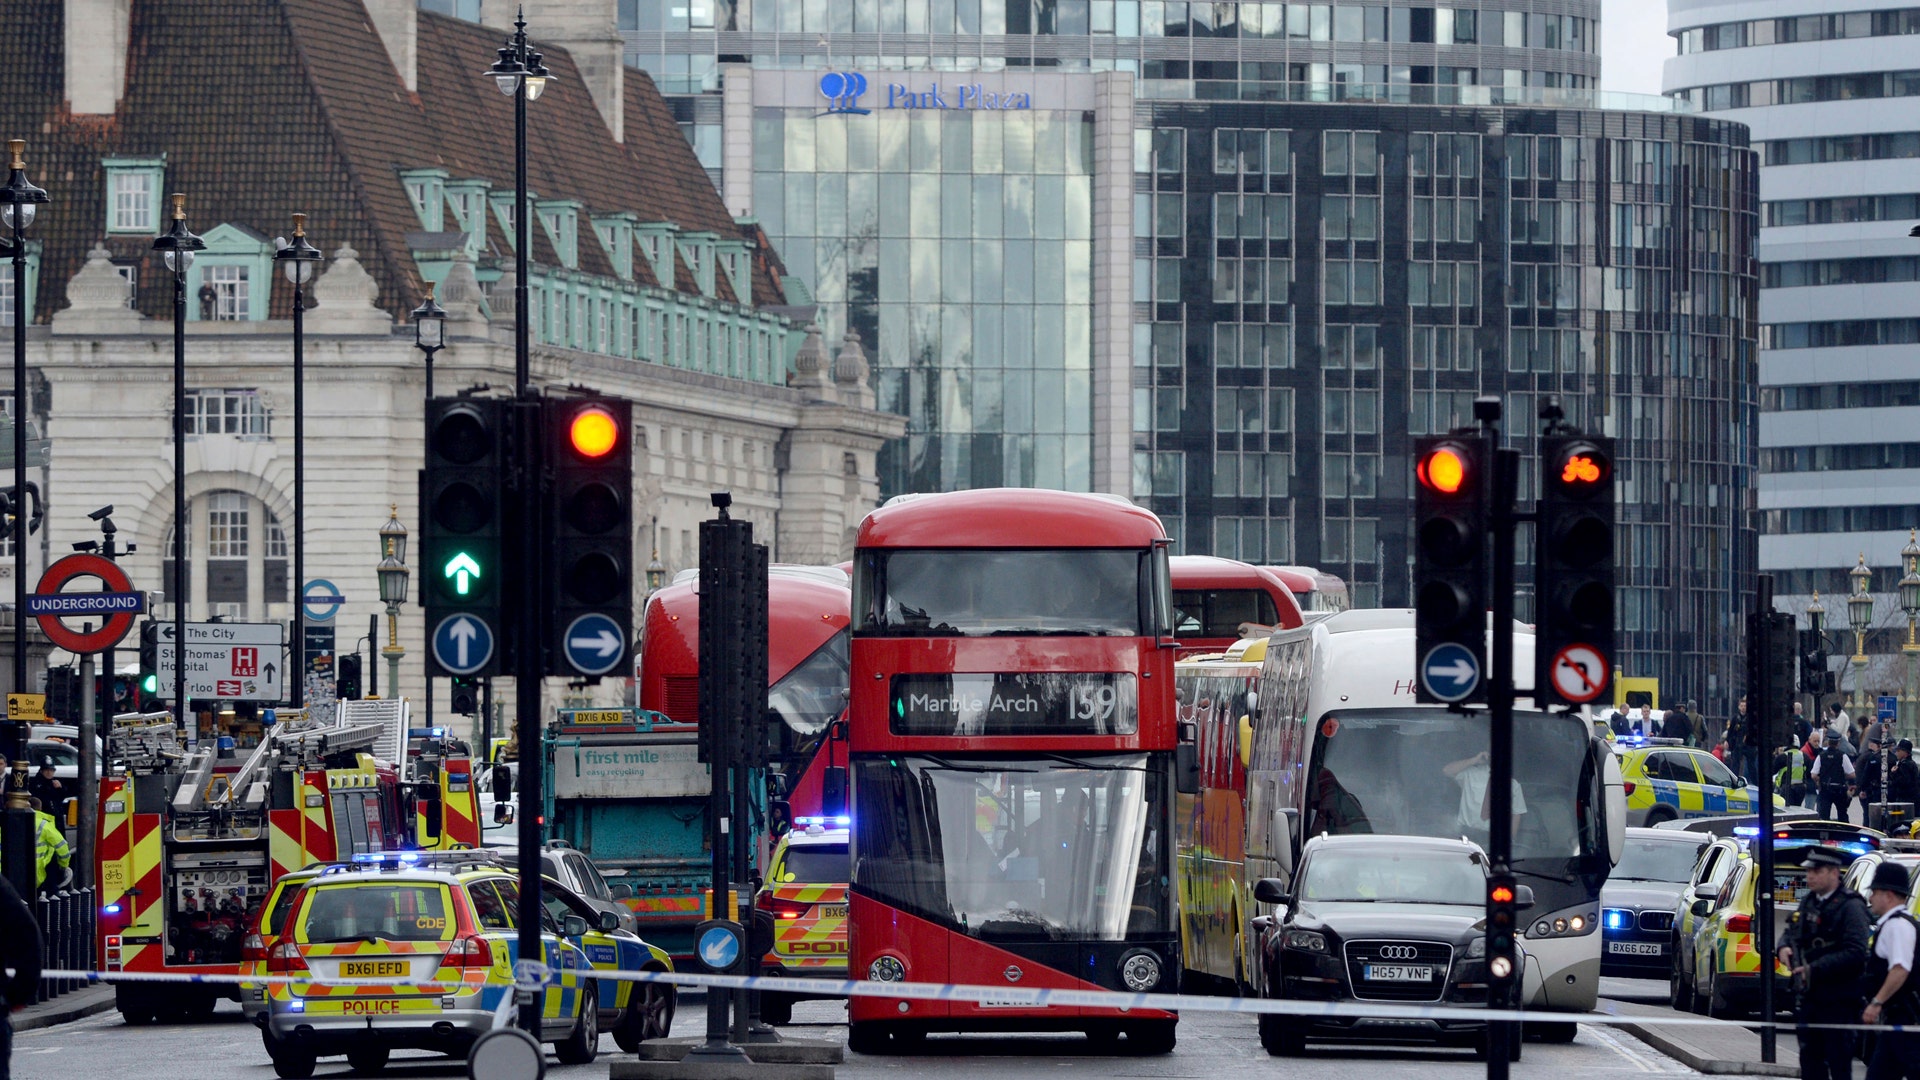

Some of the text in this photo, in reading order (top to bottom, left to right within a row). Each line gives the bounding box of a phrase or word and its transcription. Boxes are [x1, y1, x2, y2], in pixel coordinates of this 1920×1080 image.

[887, 83, 1031, 110] Park Plaza
[31, 596, 137, 610] UNDERGROUND
[187, 628, 235, 639] The City
[236, 648, 253, 667] H
[234, 668, 256, 676] A&E
[909, 684, 1117, 720] Marble Arch 159
[577, 712, 598, 722] DX16
[585, 750, 619, 764] first
[624, 749, 660, 764] mile
[586, 768, 645, 777] easy recycling
[416, 917, 445, 929] CDE
[1613, 943, 1658, 954] BX66 CZG
[347, 962, 403, 975] BX61 EFD
[1371, 966, 1430, 979] HG57 VNF
[343, 1000, 400, 1015] POLICE
